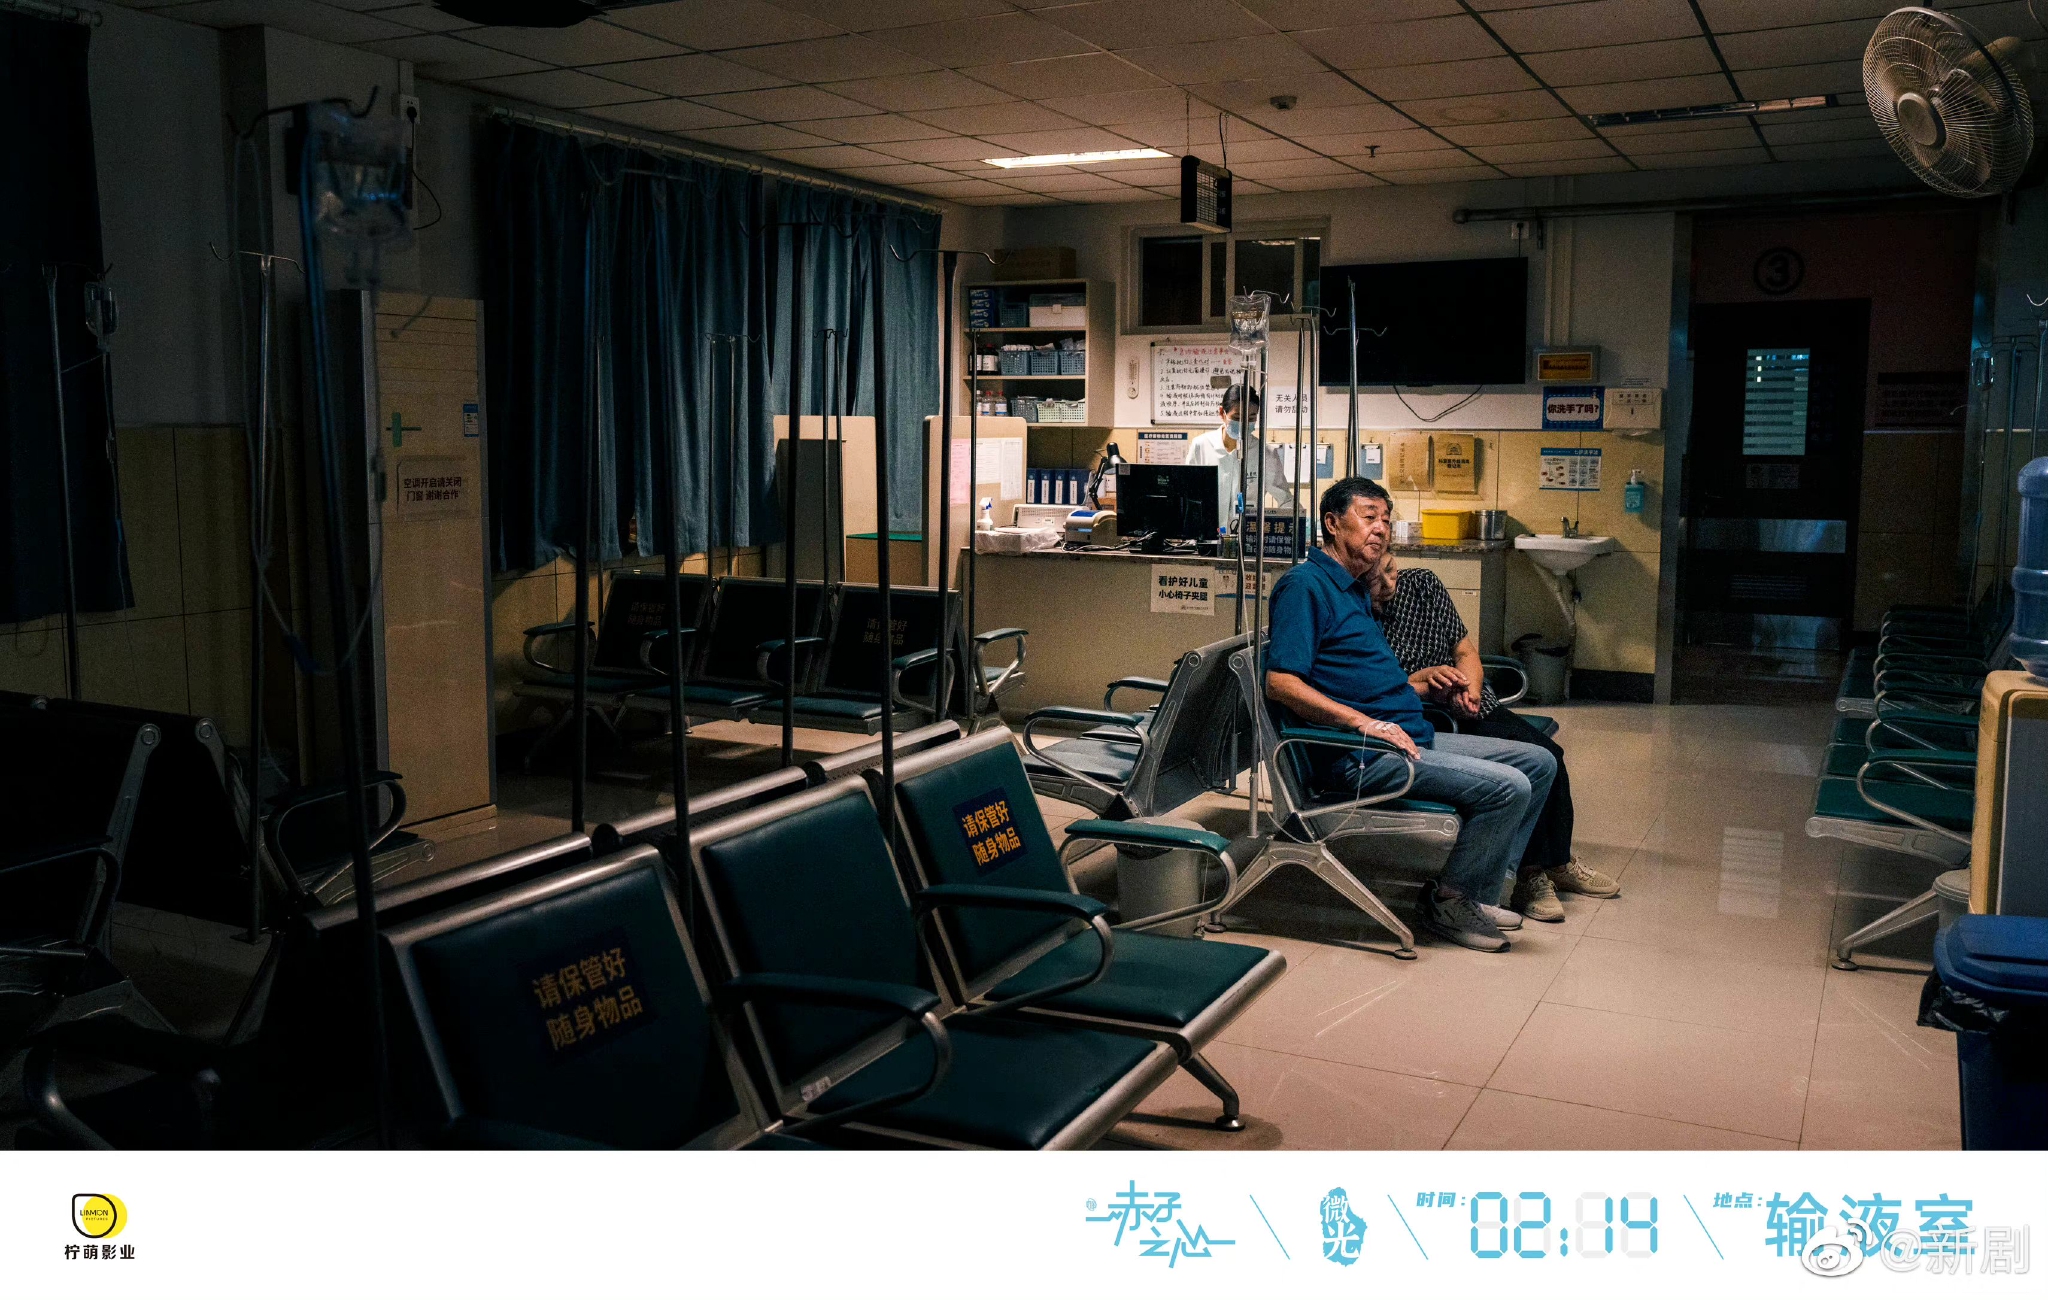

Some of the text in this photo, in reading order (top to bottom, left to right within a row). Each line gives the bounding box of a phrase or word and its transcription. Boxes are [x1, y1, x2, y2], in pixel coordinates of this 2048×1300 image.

[1547, 403, 1600, 415] 你洗手了吗?
[404, 476, 462, 489] 空调开启请关闭
[406, 489, 460, 502] 门窗 谢谢合作
[1158, 575, 1209, 589] 看护好儿童
[961, 800, 1011, 839] 请保管好
[971, 827, 1022, 867] 随身物品
[531, 946, 628, 1010] 请保管好
[546, 986, 644, 1052] 随身物品
